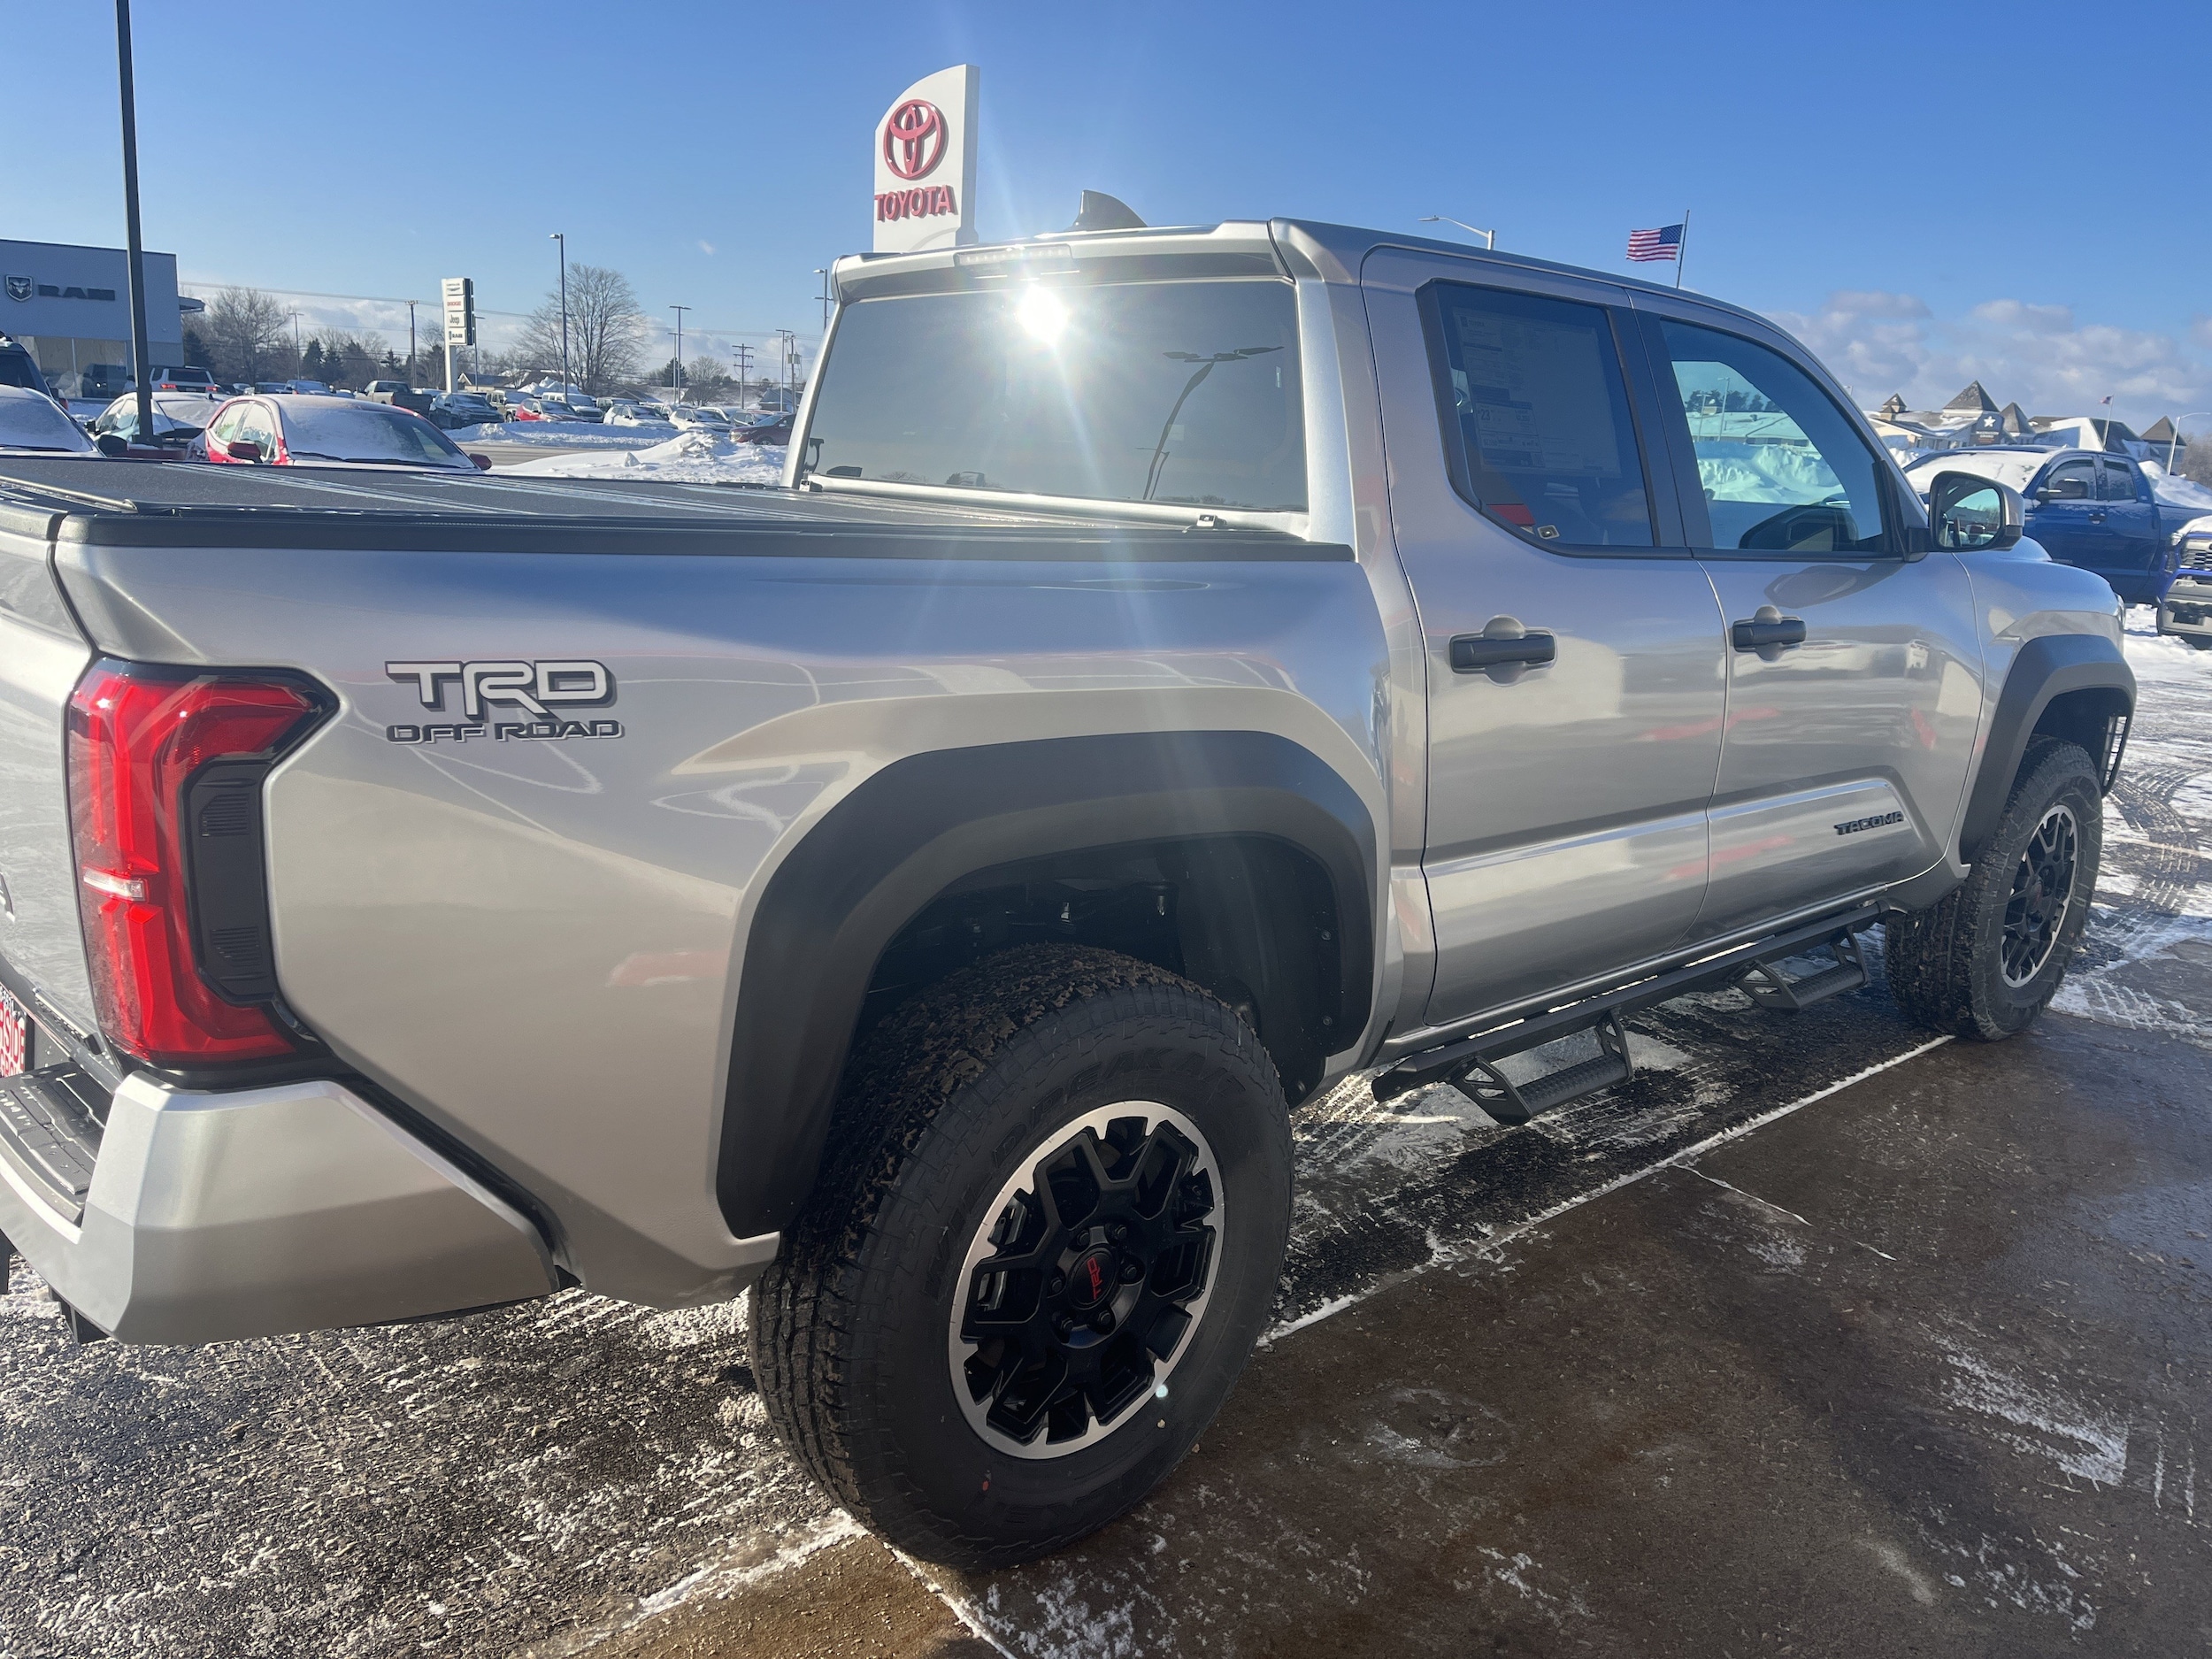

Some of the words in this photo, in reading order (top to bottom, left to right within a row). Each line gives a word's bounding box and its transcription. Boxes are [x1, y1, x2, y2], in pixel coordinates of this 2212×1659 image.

[874, 184, 957, 222] TOYOTA
[38, 284, 116, 302] RAM
[449, 314, 460, 325] Jeep
[384, 660, 618, 723] TRD
[386, 724, 486, 745] OFF
[494, 719, 625, 742] ROAD
[1833, 810, 1905, 836] TACOMA
[1087, 1257, 1103, 1301] TRD
